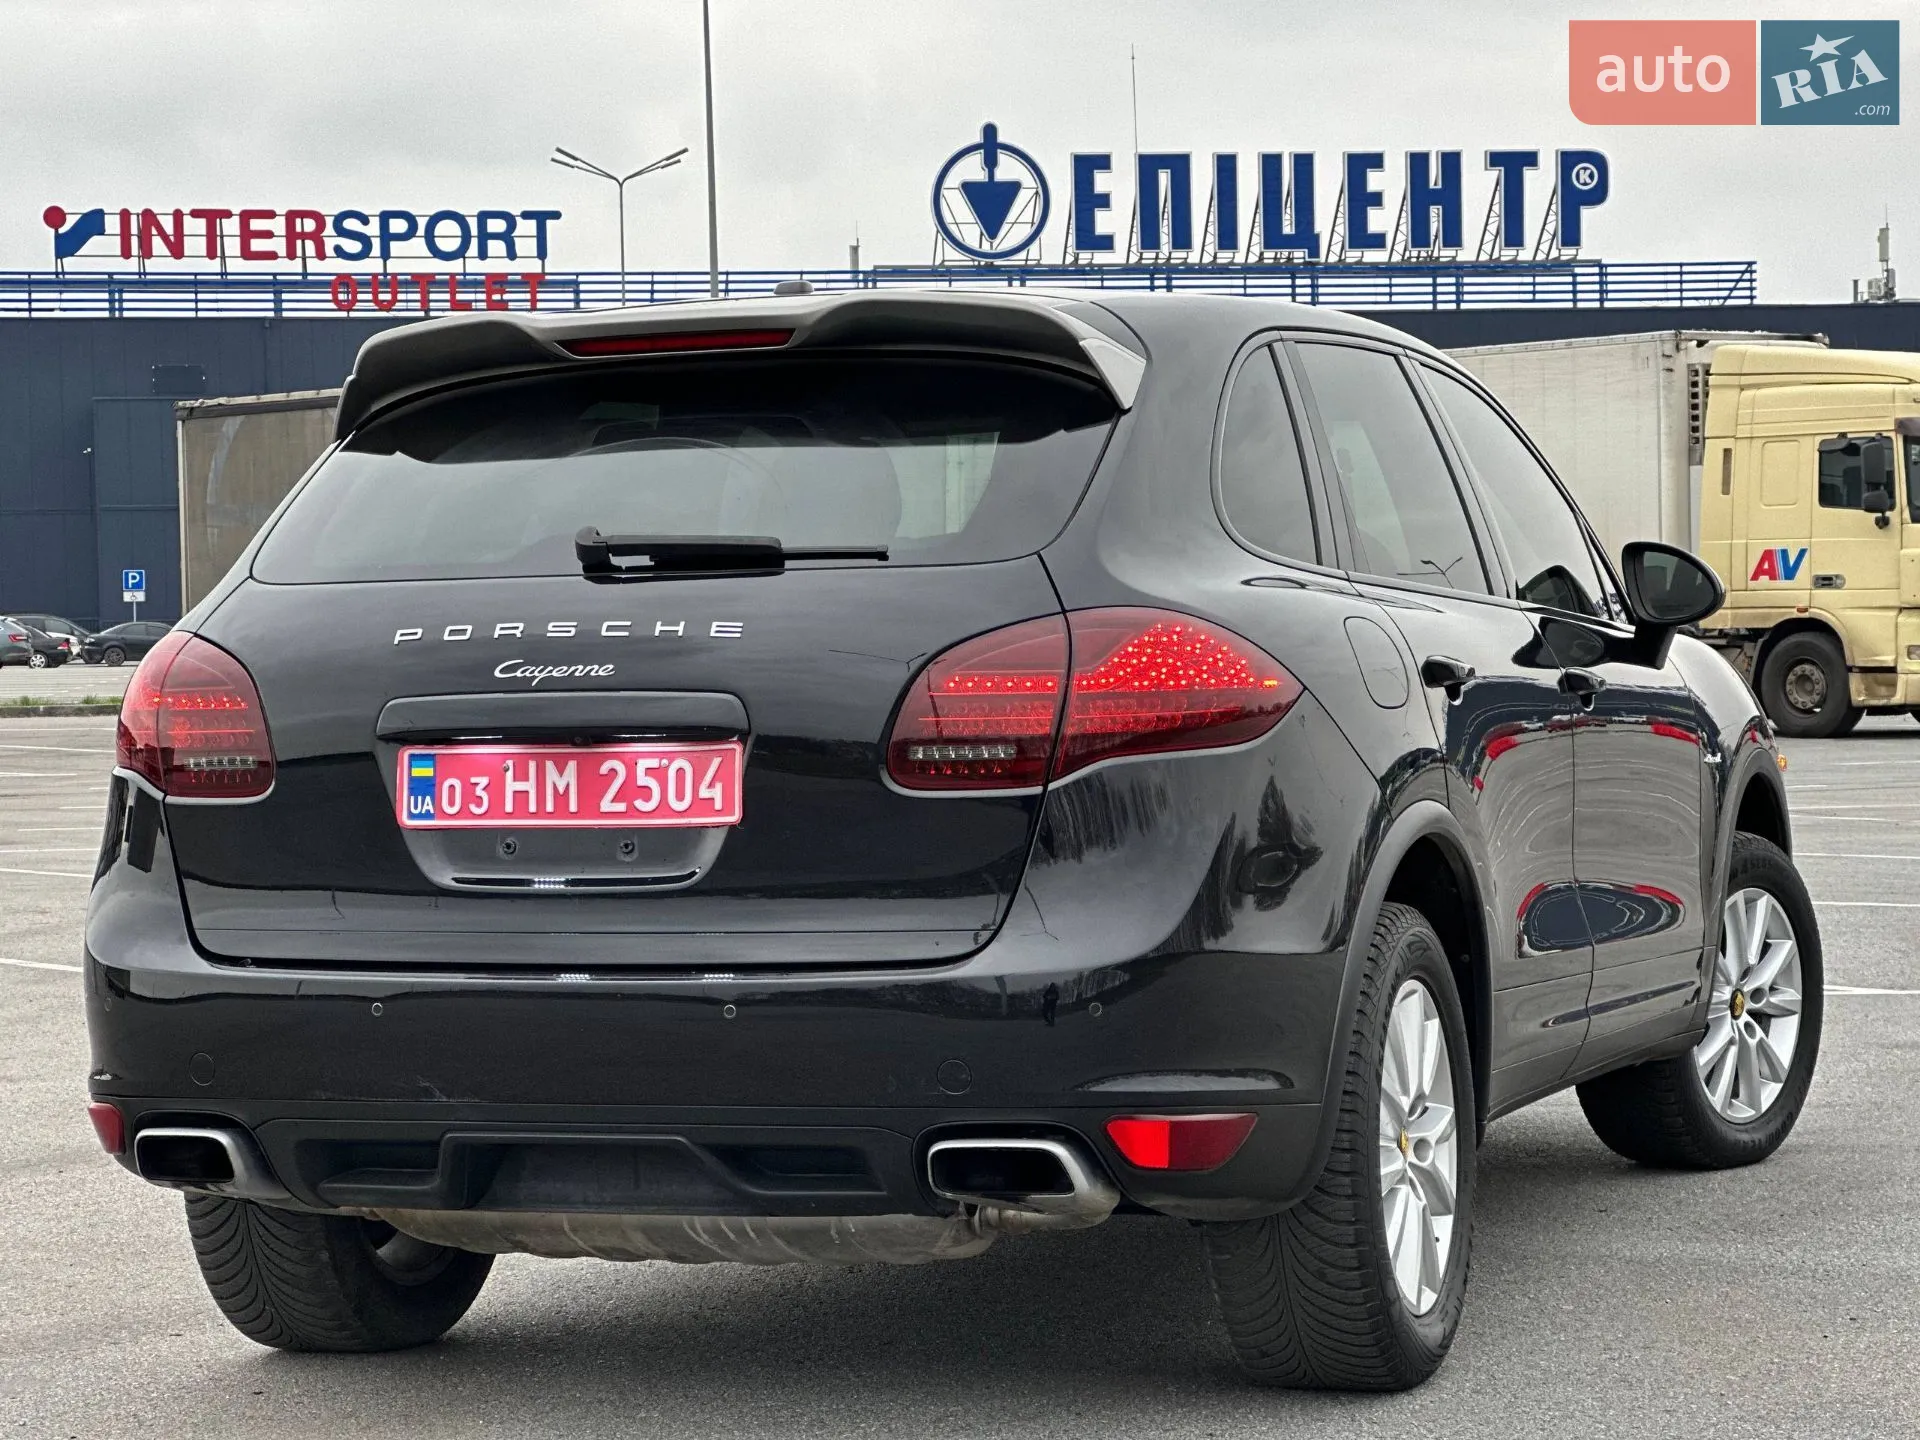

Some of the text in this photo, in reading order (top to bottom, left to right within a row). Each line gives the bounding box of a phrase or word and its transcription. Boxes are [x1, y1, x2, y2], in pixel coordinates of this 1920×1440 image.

[1071, 148, 1610, 260] ЕПІЦЕНТР
[119, 208, 562, 262] INTERSPORT
[331, 273, 546, 311] OUTLET
[128, 572, 140, 589] P
[1749, 547, 1809, 582] AV
[393, 620, 744, 645] PORSCHE
[493, 659, 616, 687] Cayenne
[440, 756, 724, 816] 03 HM 2504
[409, 795, 435, 815] UA
